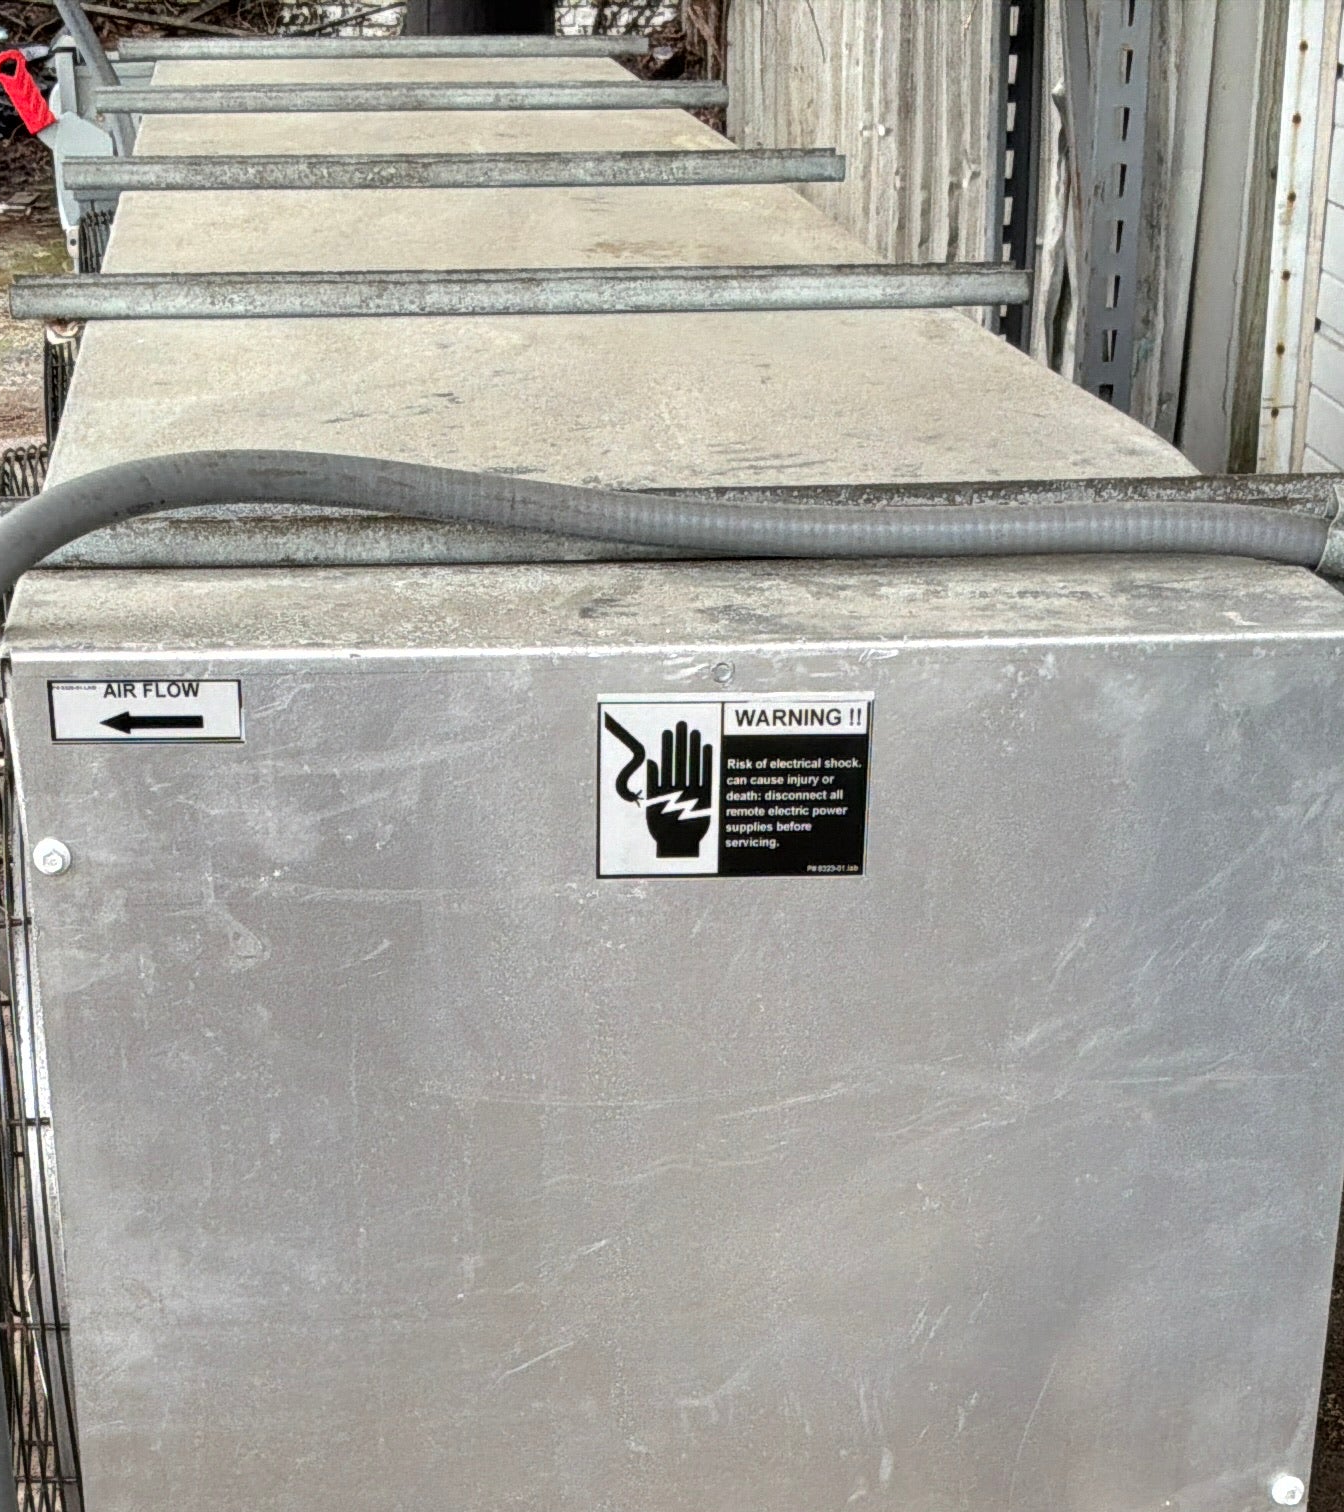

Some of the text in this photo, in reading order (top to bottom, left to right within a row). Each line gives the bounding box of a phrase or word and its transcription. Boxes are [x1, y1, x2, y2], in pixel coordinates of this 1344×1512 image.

[103, 682, 200, 698] AIR FLOW
[735, 709, 862, 727] WARNING !!
[727, 758, 753, 770] Risk
[755, 758, 767, 769] of
[769, 758, 822, 769] electrical
[726, 774, 835, 787] can cause injury or
[726, 789, 844, 801] death: disconnect all
[725, 806, 848, 818] remote electric power
[725, 821, 813, 834] supplies before
[725, 837, 780, 849] servicing.
